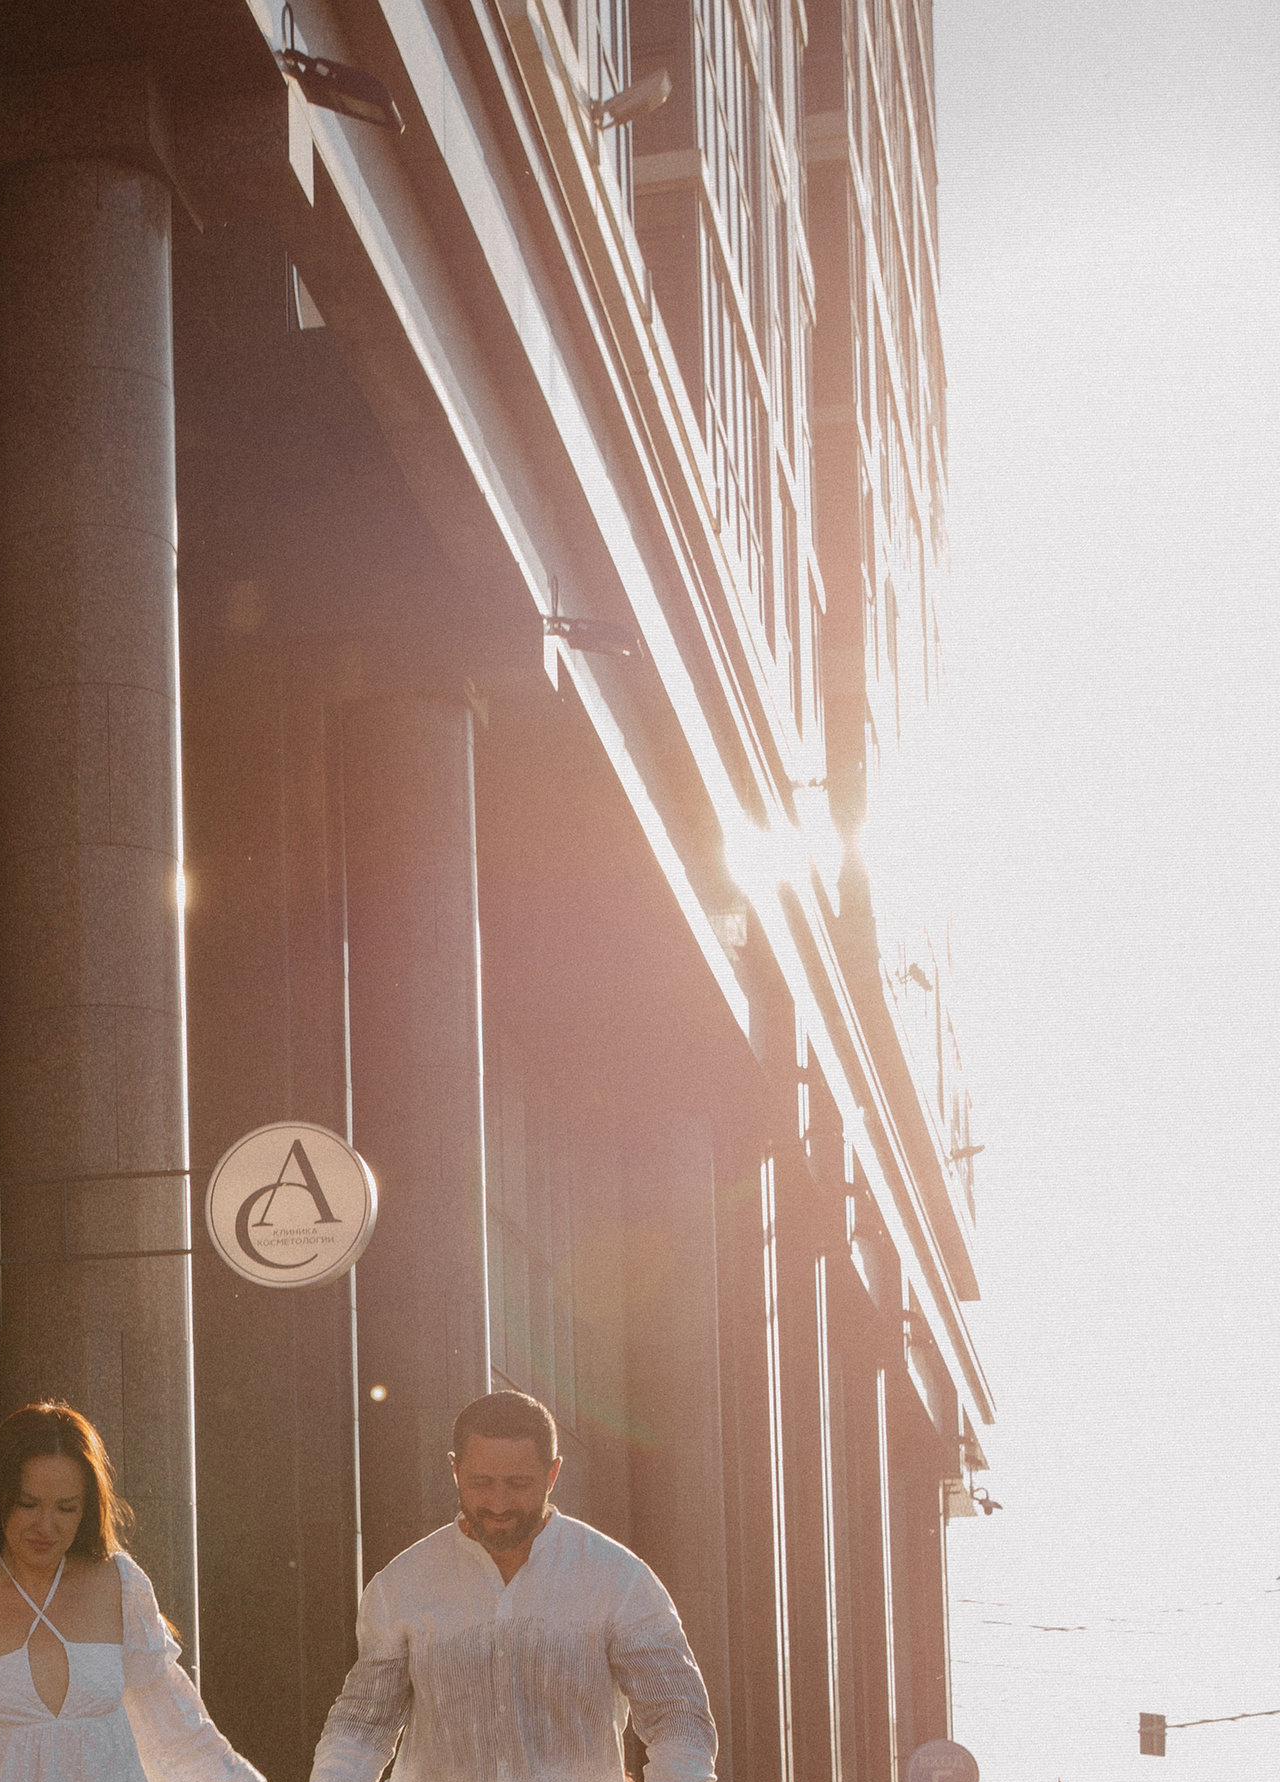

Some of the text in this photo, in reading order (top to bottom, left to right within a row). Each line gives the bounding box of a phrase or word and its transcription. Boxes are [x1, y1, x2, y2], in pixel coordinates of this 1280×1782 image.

[273, 1228, 318, 1236] КЛИНИКА
[257, 1236, 335, 1247] КОСМЕТОЛОГИИ
[919, 1755, 965, 1770] ВХОД
